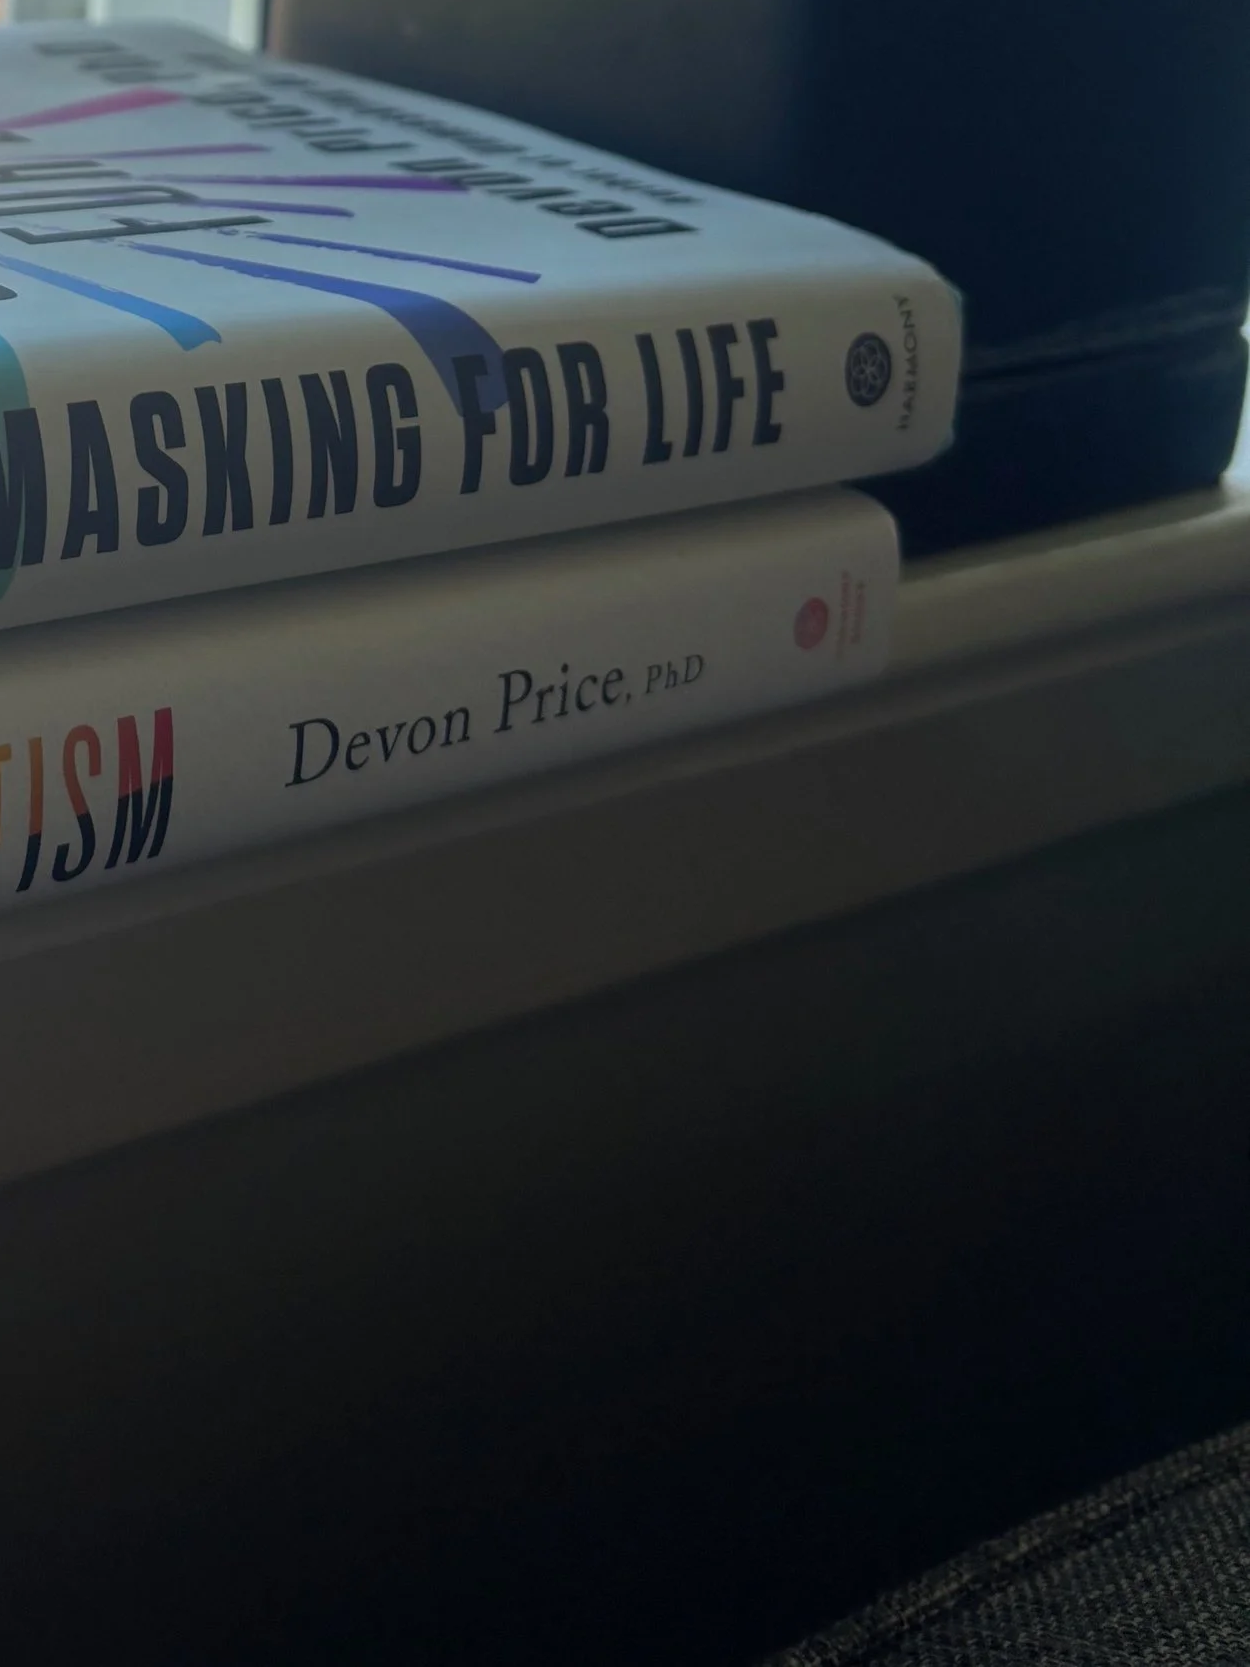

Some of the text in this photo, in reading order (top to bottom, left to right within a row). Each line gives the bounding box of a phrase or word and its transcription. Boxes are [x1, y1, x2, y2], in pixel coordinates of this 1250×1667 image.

[386, 156, 699, 239] Devon
[455, 338, 610, 495] FOR
[633, 318, 785, 465] LIFE
[892, 293, 919, 431] HARMONY
[284, 653, 705, 788] Devon Price, PhD
